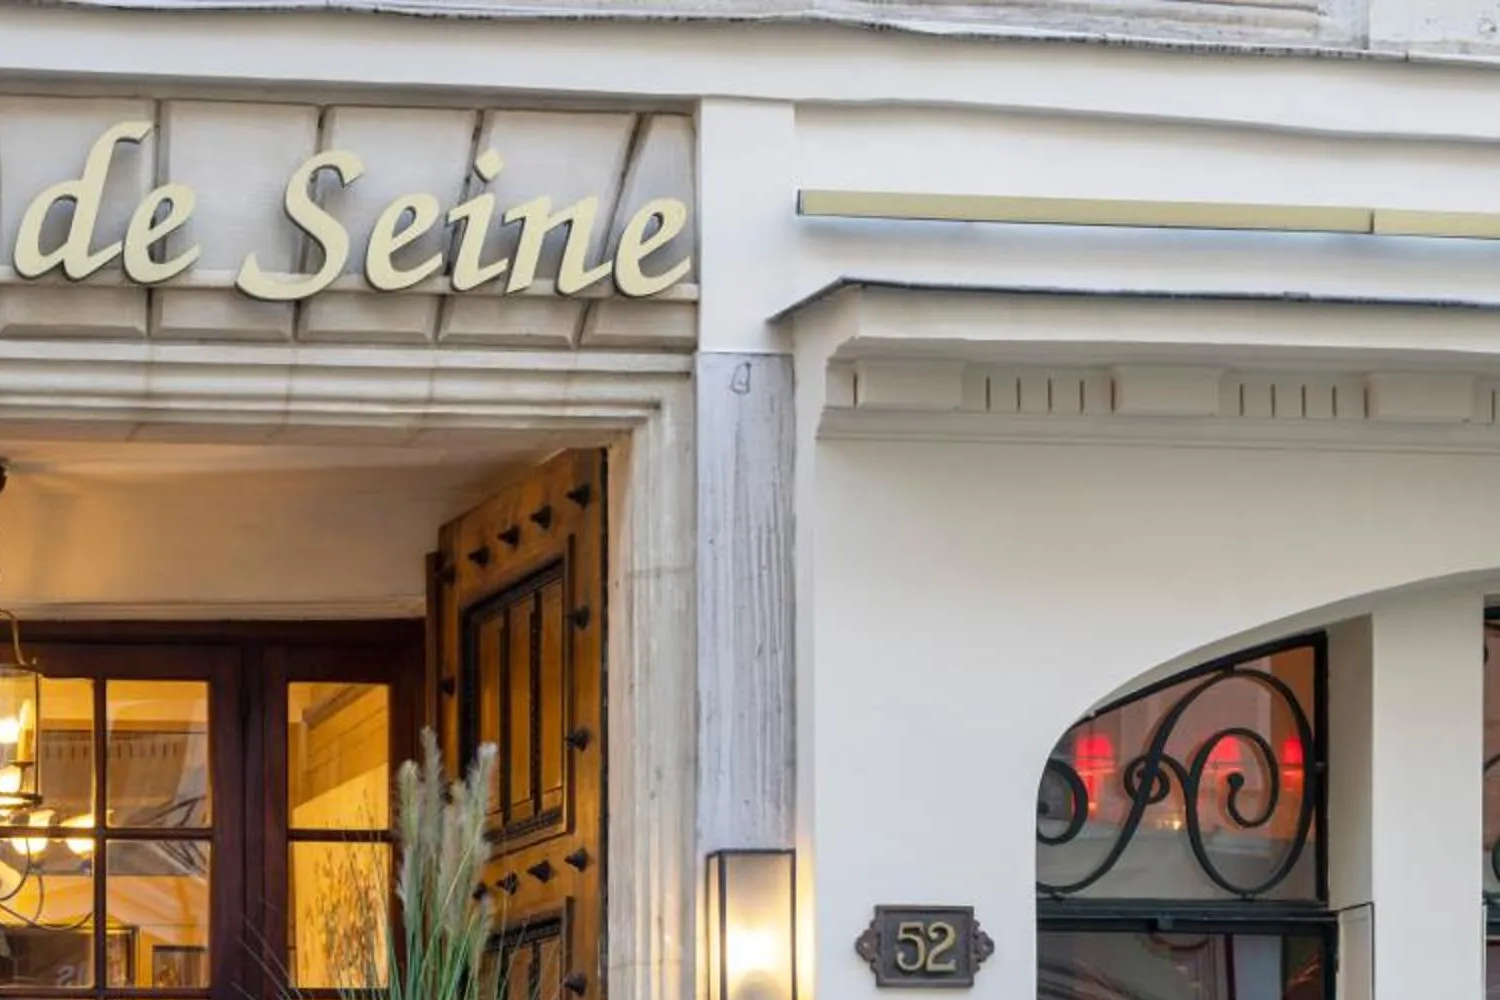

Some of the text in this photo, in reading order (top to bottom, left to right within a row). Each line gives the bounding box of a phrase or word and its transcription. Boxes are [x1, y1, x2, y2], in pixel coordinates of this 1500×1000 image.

[11, 118, 199, 283] de
[236, 149, 692, 300] Seine
[896, 921, 956, 972] 52
